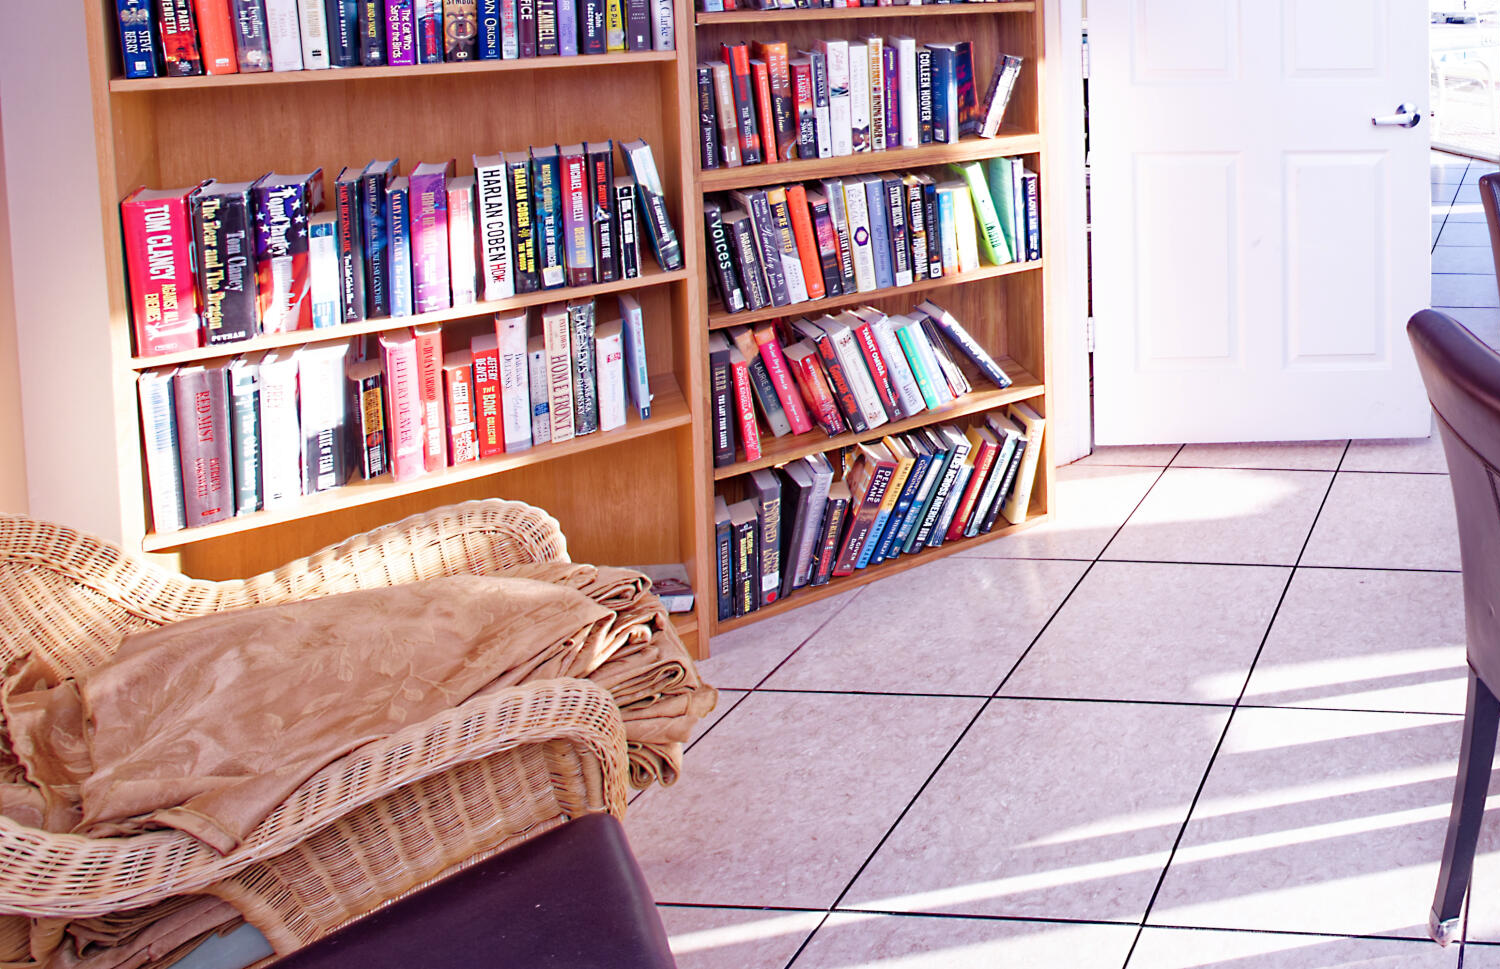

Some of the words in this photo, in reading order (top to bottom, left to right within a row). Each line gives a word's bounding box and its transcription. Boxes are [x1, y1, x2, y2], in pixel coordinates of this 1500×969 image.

[177, 7, 190, 32] PARIS
[484, 17, 497, 48] ORIGIN
[537, 9, 555, 41] CANNELL
[125, 31, 138, 54] BERRY
[138, 30, 152, 52] STEVE
[770, 56, 780, 89] HANNAH
[779, 55, 788, 88] KRISTIN
[919, 53, 930, 88] COLLEEN
[776, 98, 784, 116] Great
[921, 88, 931, 122] HOOVER
[743, 118, 753, 148] WHISTLER
[513, 168, 527, 201] HARLAN
[570, 163, 582, 190] MICHAEL
[1027, 178, 1037, 197] YOU
[268, 190, 286, 216] Tom
[392, 193, 401, 214] MARY
[483, 170, 503, 217] HARLAN
[571, 190, 584, 222] CONNELLY
[889, 187, 901, 206] STREET
[144, 204, 171, 233] TOM
[202, 198, 220, 220] The
[516, 201, 530, 228] COBEN
[775, 204, 788, 227] YOU'RE
[911, 200, 924, 232] KELLERMAN
[1028, 197, 1038, 220] LOVE
[203, 220, 222, 247] Bear
[267, 216, 290, 257] Clancy
[393, 215, 402, 236] JANE
[226, 230, 245, 254] Tom
[394, 237, 403, 261] CLARK
[487, 222, 507, 262] COBEN
[711, 219, 731, 270] VOICES
[759, 222, 774, 270] Pemberley
[780, 227, 793, 253] INVITED
[146, 234, 177, 281] CLANCY
[204, 249, 224, 268] and
[740, 232, 755, 264] PARANOID
[749, 279, 762, 307] JACKSON
[913, 238, 928, 274] HANGMAN
[205, 269, 225, 292] The
[225, 257, 247, 291] Clancy
[490, 265, 505, 283] HOME
[144, 294, 161, 322] ENEMIES
[162, 284, 178, 310] AGAINST
[204, 292, 226, 329] Dragon
[574, 313, 586, 340] LAKE
[577, 341, 589, 374] NEWS
[862, 327, 875, 353] TARGET
[872, 352, 885, 377] OMEGA
[475, 358, 487, 383] DEAVER
[487, 356, 497, 380] JEFFERY
[551, 355, 569, 392] HOME
[736, 366, 745, 386] SOPHIE
[754, 361, 769, 386] LAURIE
[809, 366, 820, 386] STEPHEN
[195, 390, 211, 416] RED
[483, 394, 496, 417] BONE
[553, 394, 571, 431] FRONT
[739, 386, 748, 414] KINSELLA
[197, 415, 214, 443] MIST
[400, 405, 412, 444] DEAVER
[487, 416, 496, 444] COLLECTOR
[867, 470, 883, 503] LEHANE
[874, 470, 891, 503] DENNIS
[937, 470, 957, 496] ACROSS
[1001, 460, 1018, 495] PASSENGER
[923, 496, 945, 527] AMERICA
[849, 538, 857, 551] DAY
[858, 529, 867, 542] THE
[850, 540, 863, 561] GIVEN
